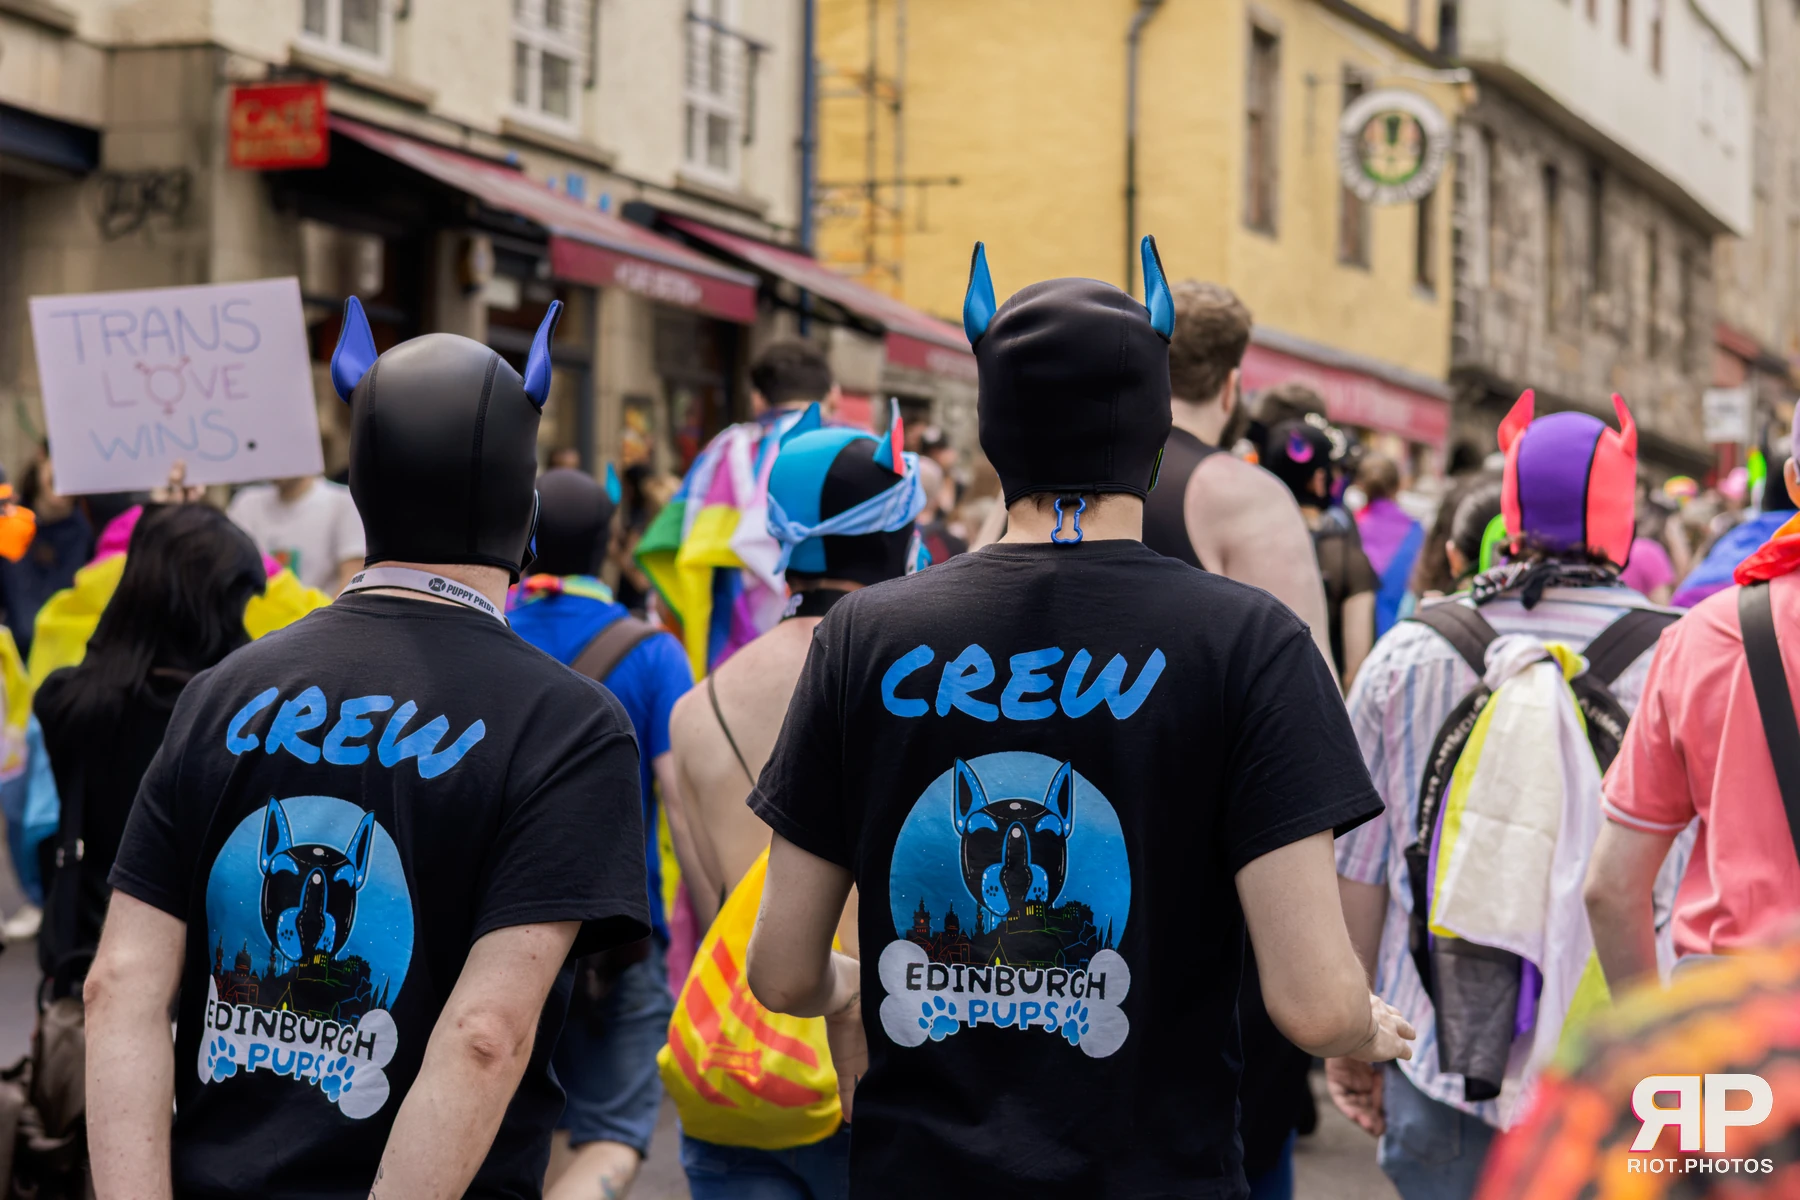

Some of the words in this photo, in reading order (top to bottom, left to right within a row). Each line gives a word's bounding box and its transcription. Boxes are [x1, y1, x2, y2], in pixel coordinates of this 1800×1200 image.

[50, 298, 262, 365] TRANS
[446, 584, 474, 602] PUPPY
[473, 596, 495, 614] PRIDE
[883, 644, 1166, 722] CREW
[226, 686, 486, 779] CREW
[906, 963, 1106, 1000] EDINBURGH
[207, 999, 377, 1061] EDINBURGH
[967, 1000, 1059, 1033] PUPS
[247, 1043, 326, 1084] PUPS
